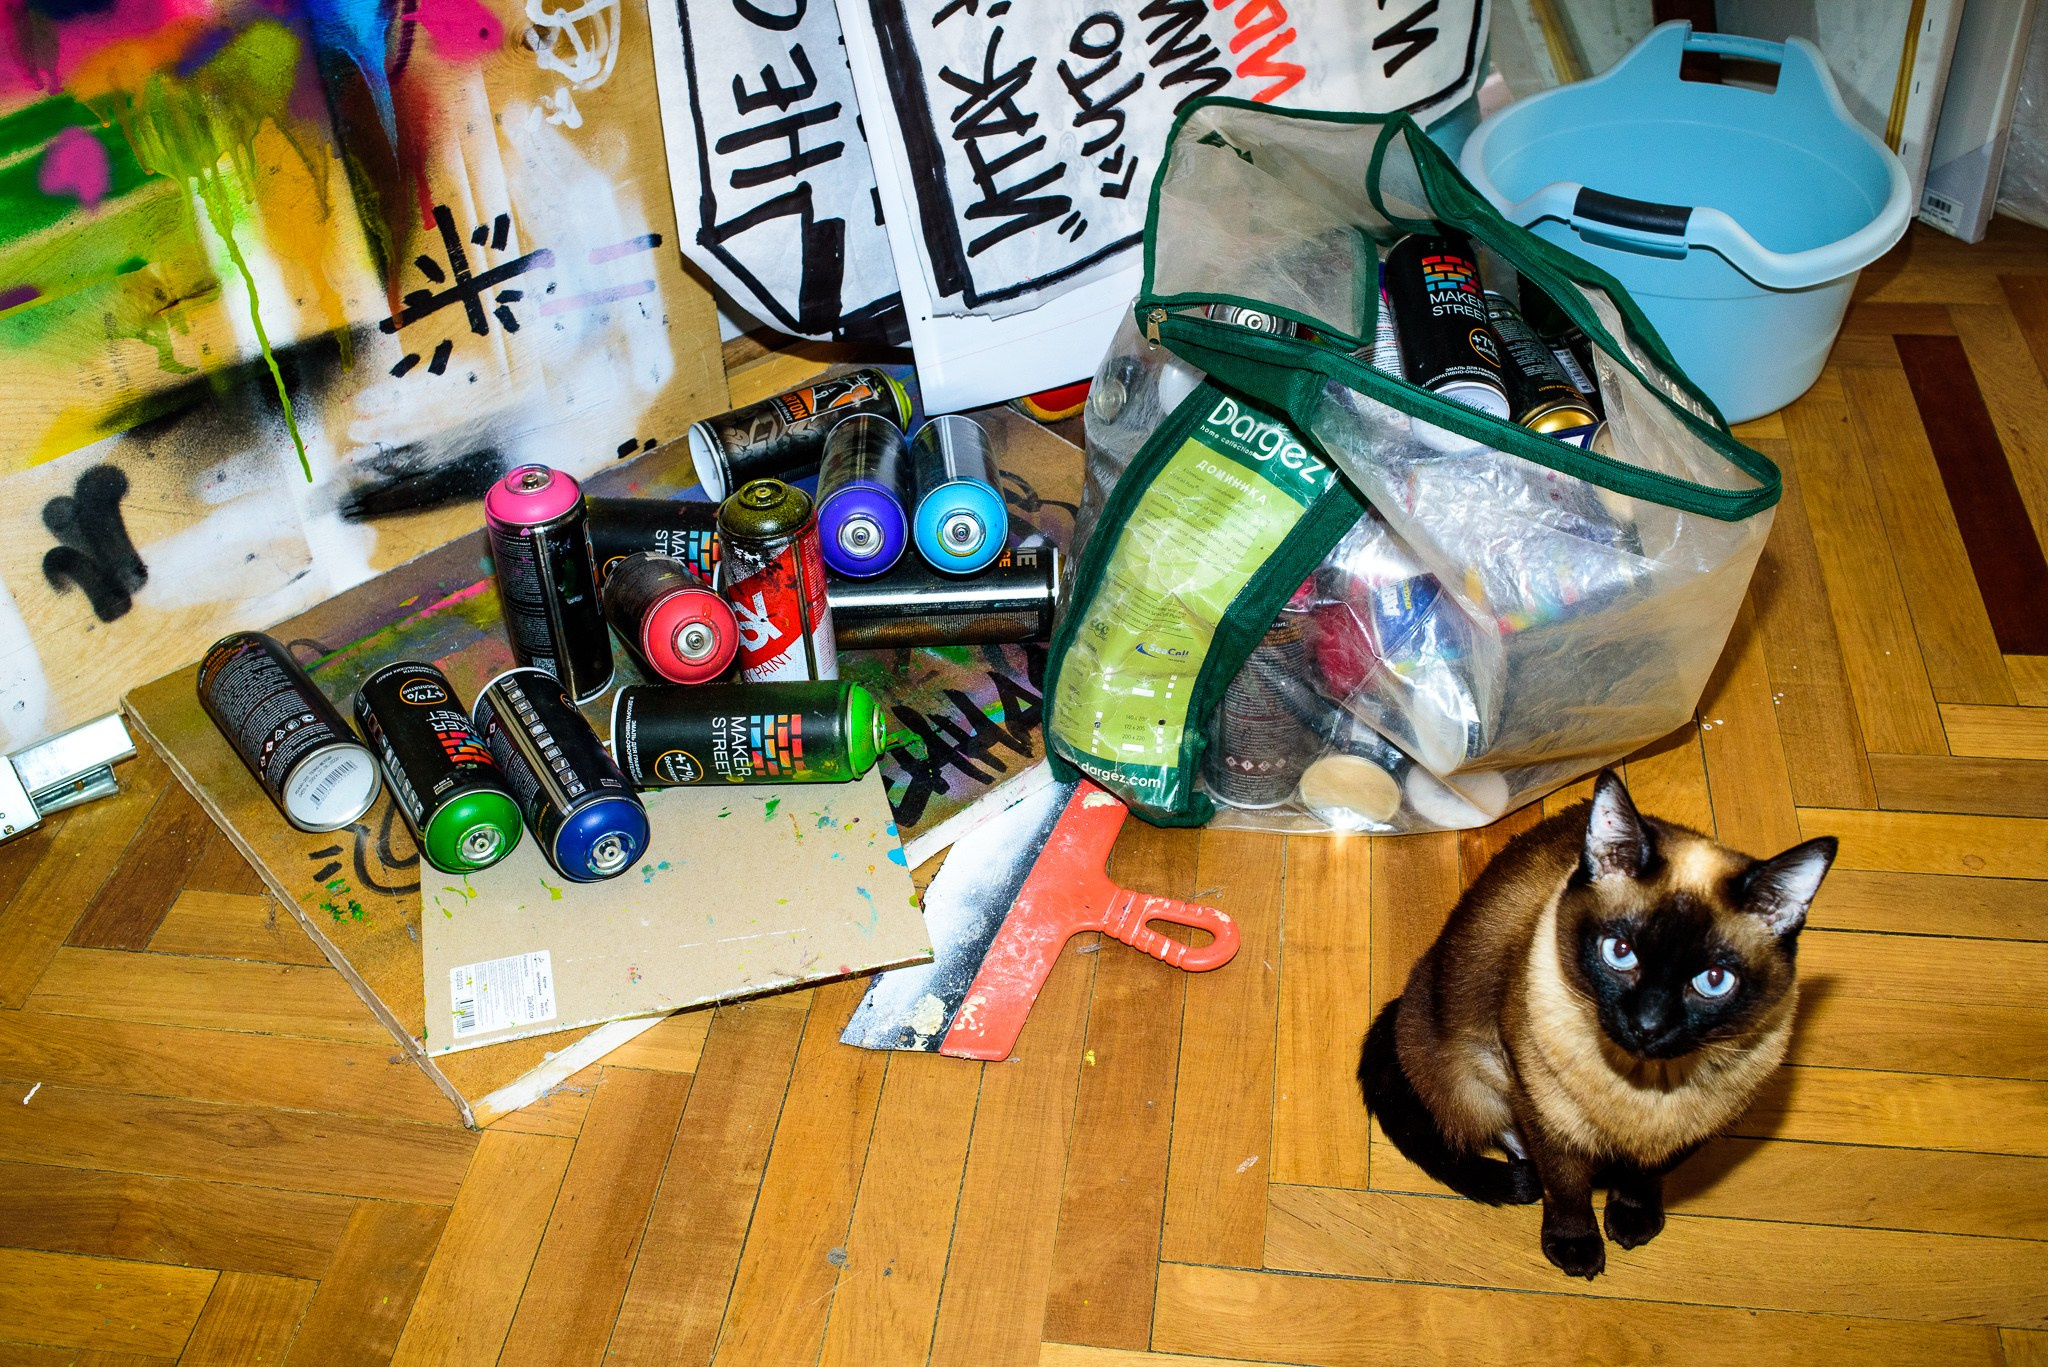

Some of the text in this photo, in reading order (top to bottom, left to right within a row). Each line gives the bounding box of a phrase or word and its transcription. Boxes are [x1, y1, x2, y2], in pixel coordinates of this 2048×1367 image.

[1429, 290, 1487, 313] MAKER
[1432, 303, 1488, 324] STREET
[1200, 425, 1255, 457] home collection
[1207, 397, 1327, 485] Dargez
[1196, 459, 1267, 506] ДОМИНИКА
[671, 530, 688, 567] MAK
[1148, 643, 1189, 657] SeaCell
[755, 652, 793, 680] PAINT
[406, 688, 445, 702] +7%
[429, 710, 474, 726] REET
[431, 720, 479, 738] AKER
[712, 716, 732, 777] STREET
[731, 716, 752, 777] MAKER
[664, 755, 680, 782] бесплатно
[675, 753, 695, 782] +7%
